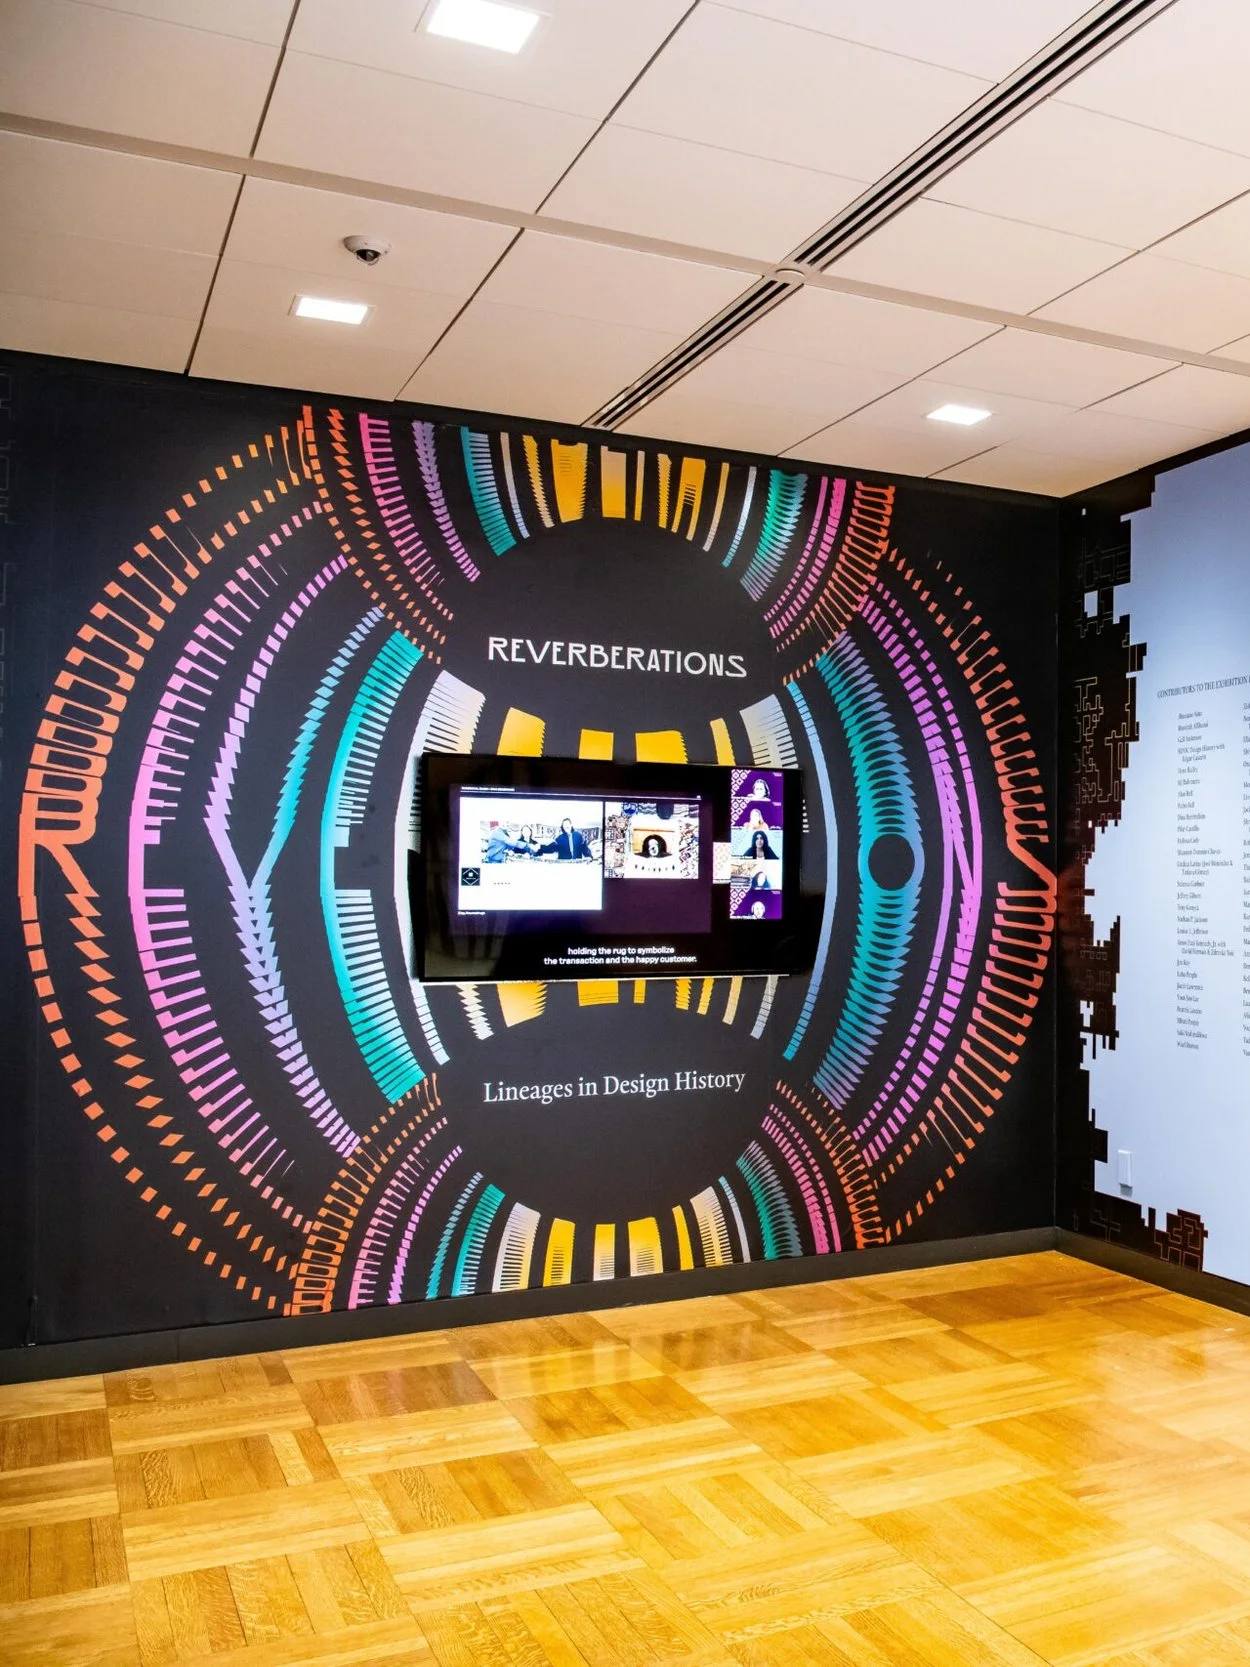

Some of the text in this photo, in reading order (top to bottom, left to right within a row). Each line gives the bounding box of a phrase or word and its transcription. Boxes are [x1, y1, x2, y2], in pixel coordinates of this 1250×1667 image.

[488, 636, 747, 678] REVERBERATIONS
[543, 957, 558, 965] the
[559, 957, 604, 965] transaction
[605, 956, 620, 964] and
[621, 956, 635, 964] the
[636, 955, 659, 965] happy
[567, 946, 675, 956] holding the rug to symbolize
[483, 1070, 746, 1104] Lineages in Design History
